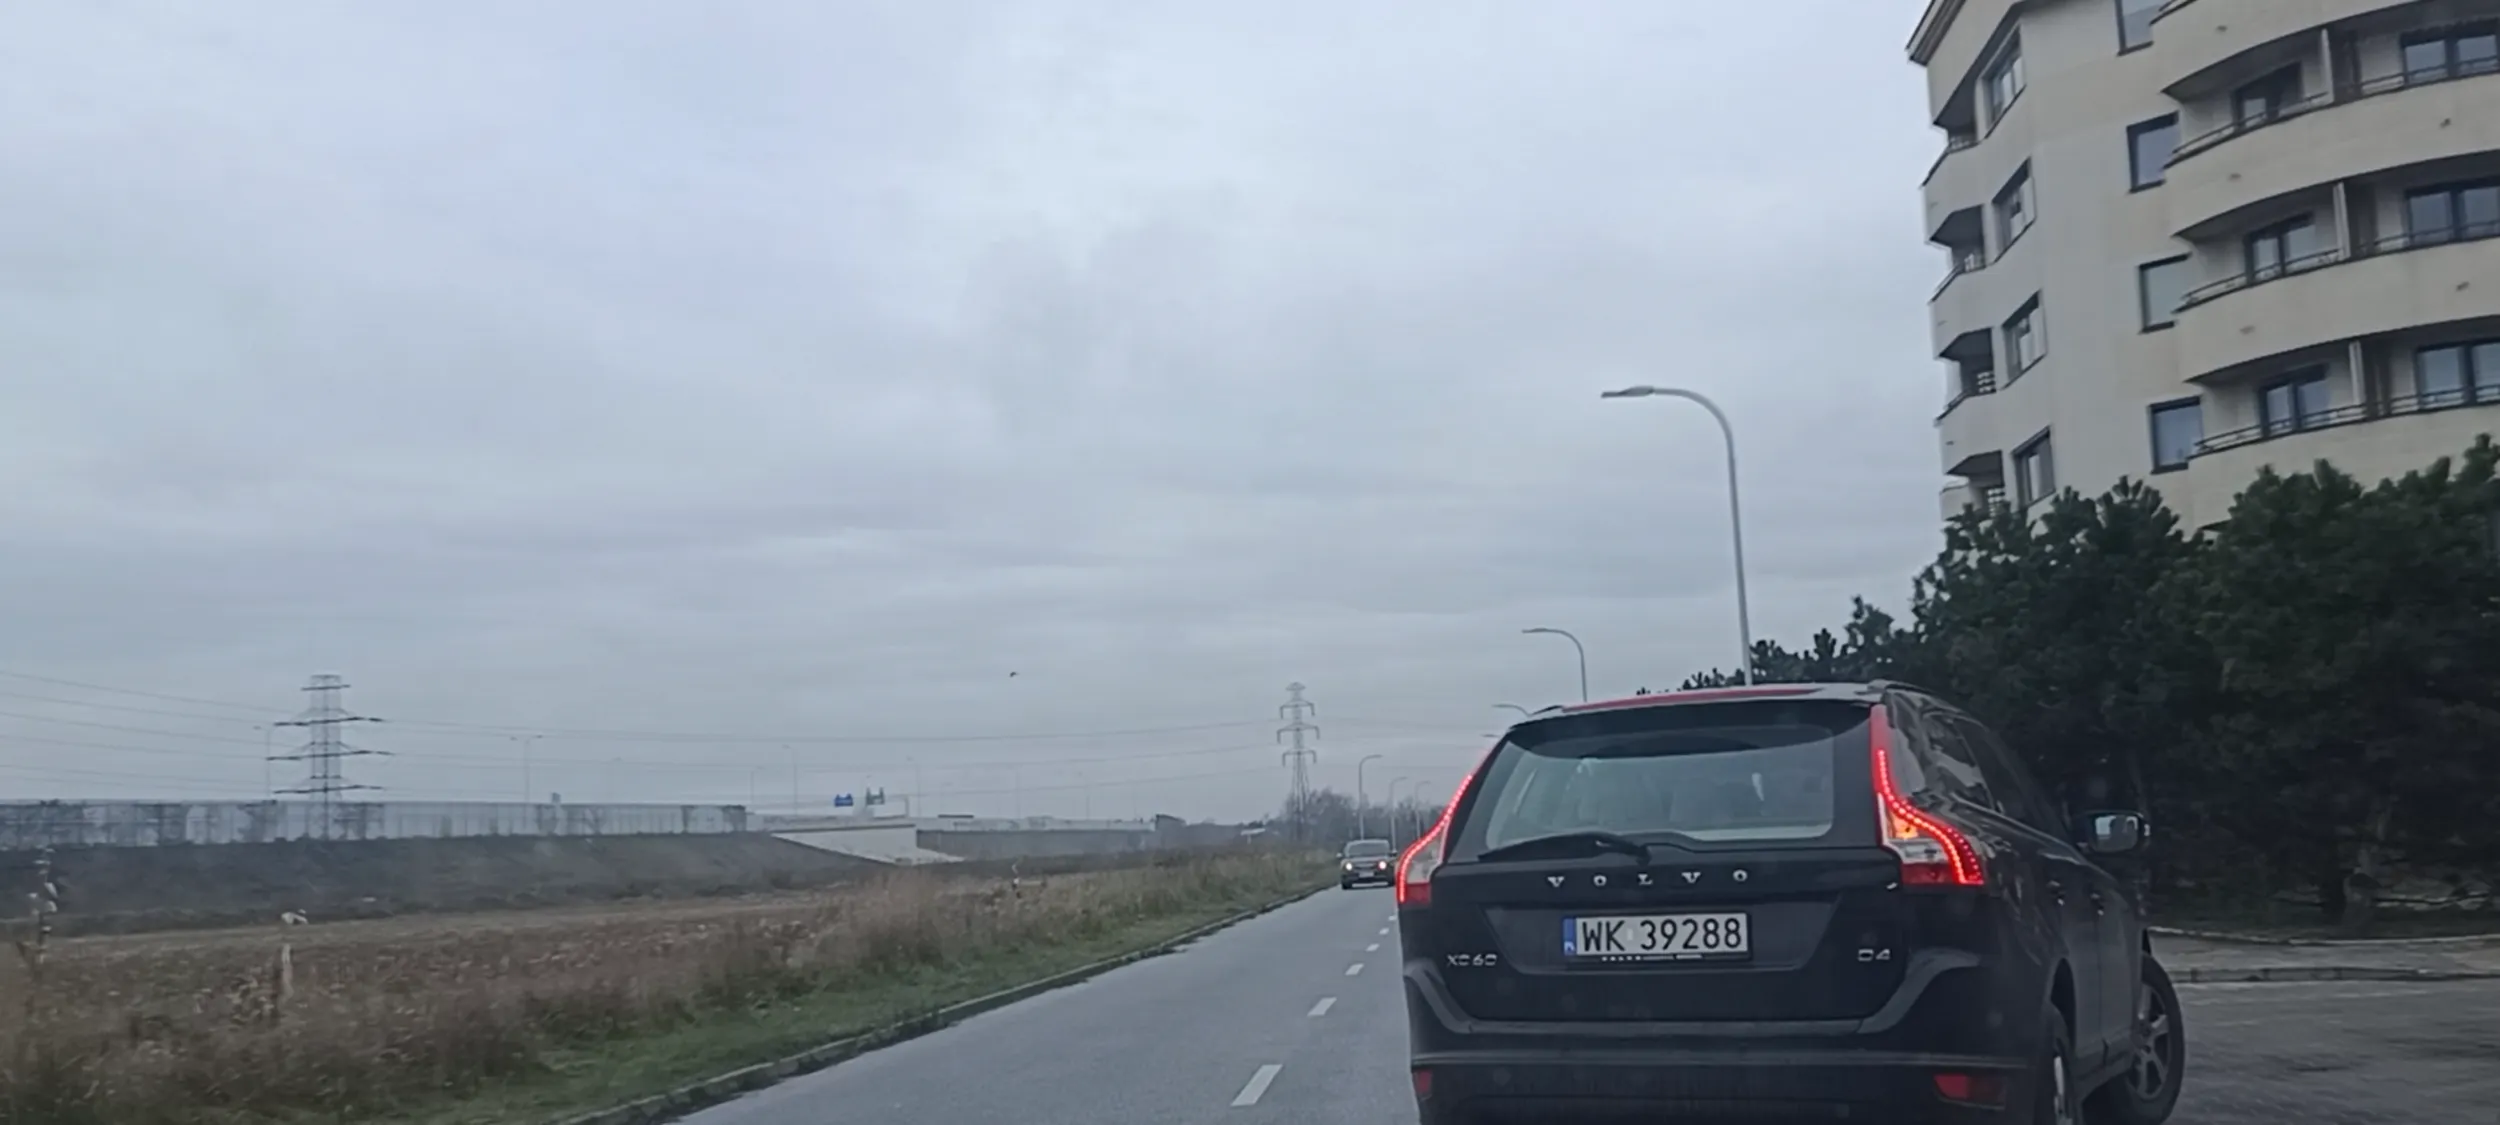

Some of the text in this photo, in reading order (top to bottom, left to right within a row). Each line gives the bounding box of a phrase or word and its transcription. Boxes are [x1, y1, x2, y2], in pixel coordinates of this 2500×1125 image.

[1548, 869, 1748, 888] VOLVO
[1582, 918, 1741, 952] WK 39288
[1858, 949, 1890, 961] D4
